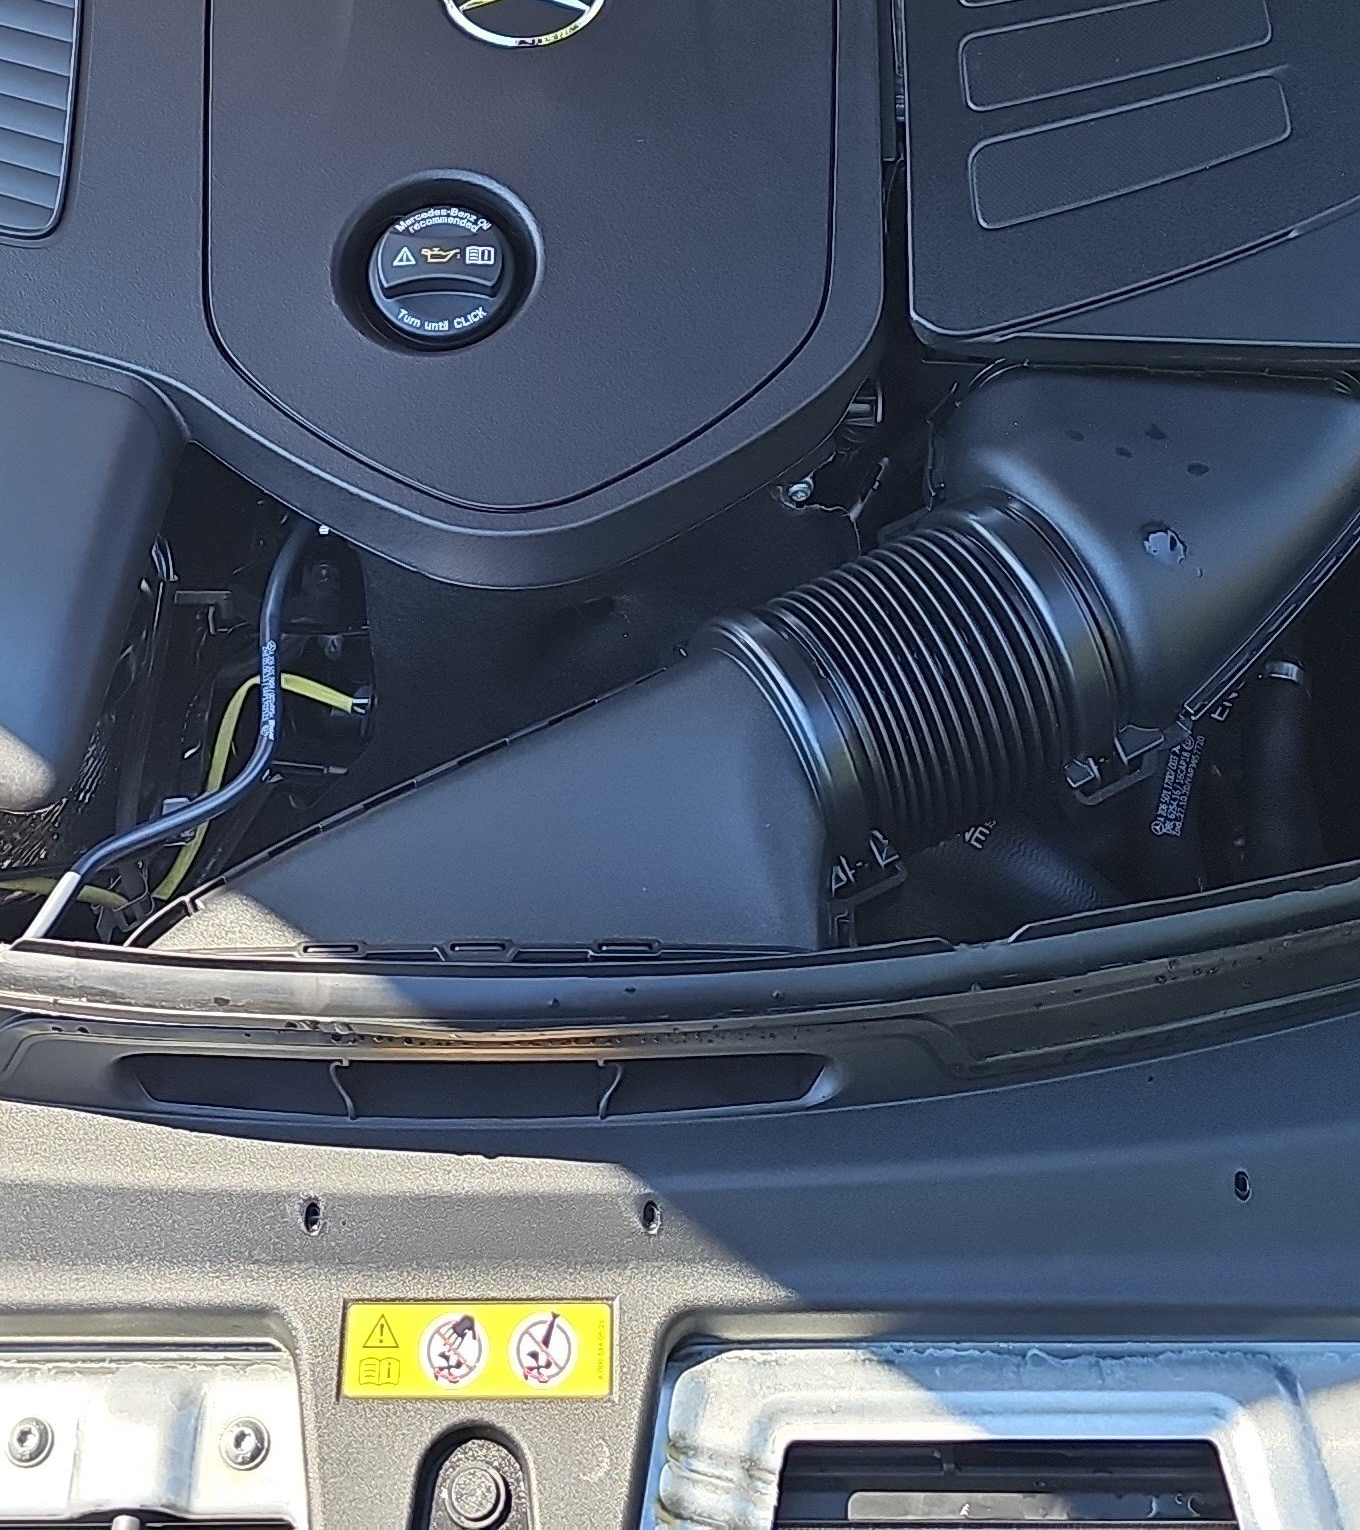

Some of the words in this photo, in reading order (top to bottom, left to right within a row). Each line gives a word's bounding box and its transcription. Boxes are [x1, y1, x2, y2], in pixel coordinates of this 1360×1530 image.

[394, 207, 476, 233] Mercedes-Benz
[408, 216, 480, 234] recommended
[397, 308, 422, 328] Turn
[424, 320, 450, 332] until
[453, 306, 488, 330] CLICK
